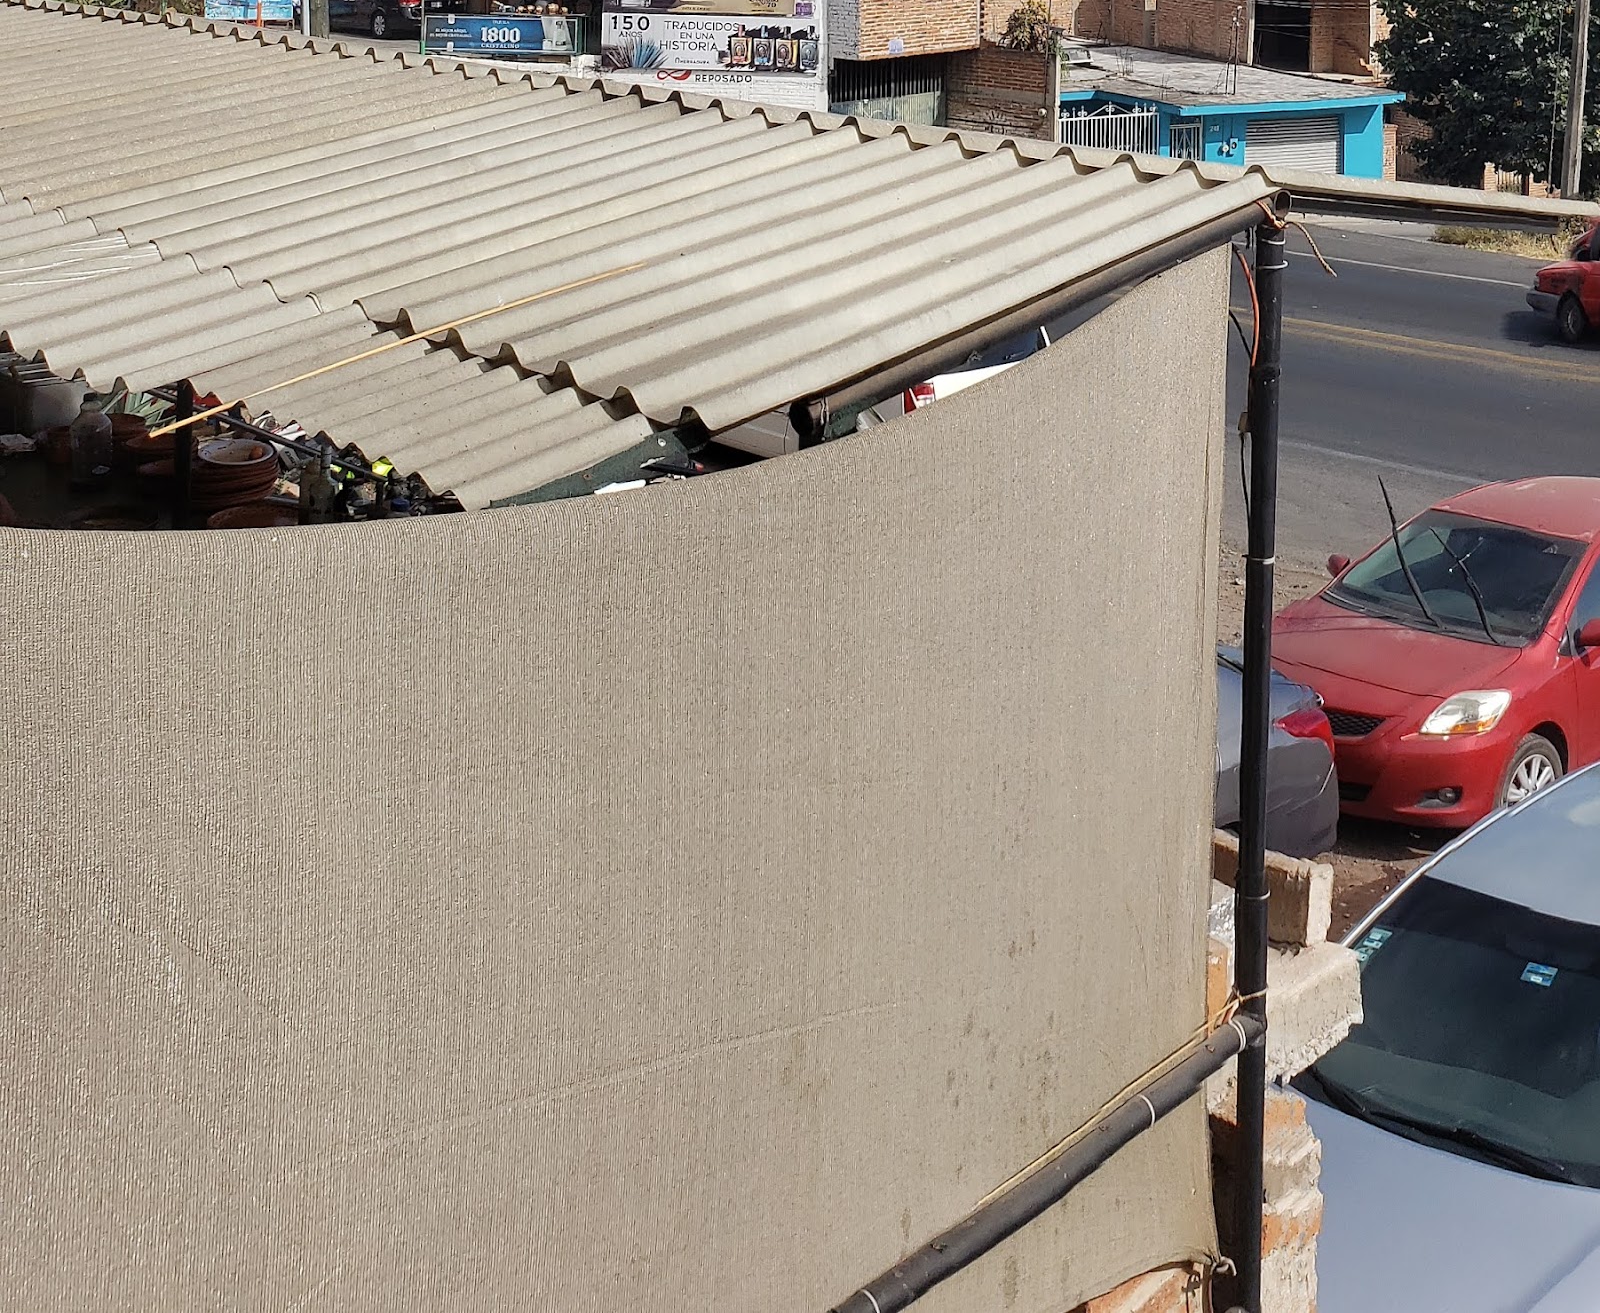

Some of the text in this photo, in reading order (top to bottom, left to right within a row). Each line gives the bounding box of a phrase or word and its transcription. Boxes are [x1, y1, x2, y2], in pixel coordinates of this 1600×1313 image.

[611, 15, 650, 31] 150
[664, 20, 739, 32] TRADUCIDOS
[480, 26, 521, 43] 1800
[696, 32, 715, 40] UNA
[659, 40, 718, 52] HISTORIA
[695, 74, 752, 83] REPOSADO
